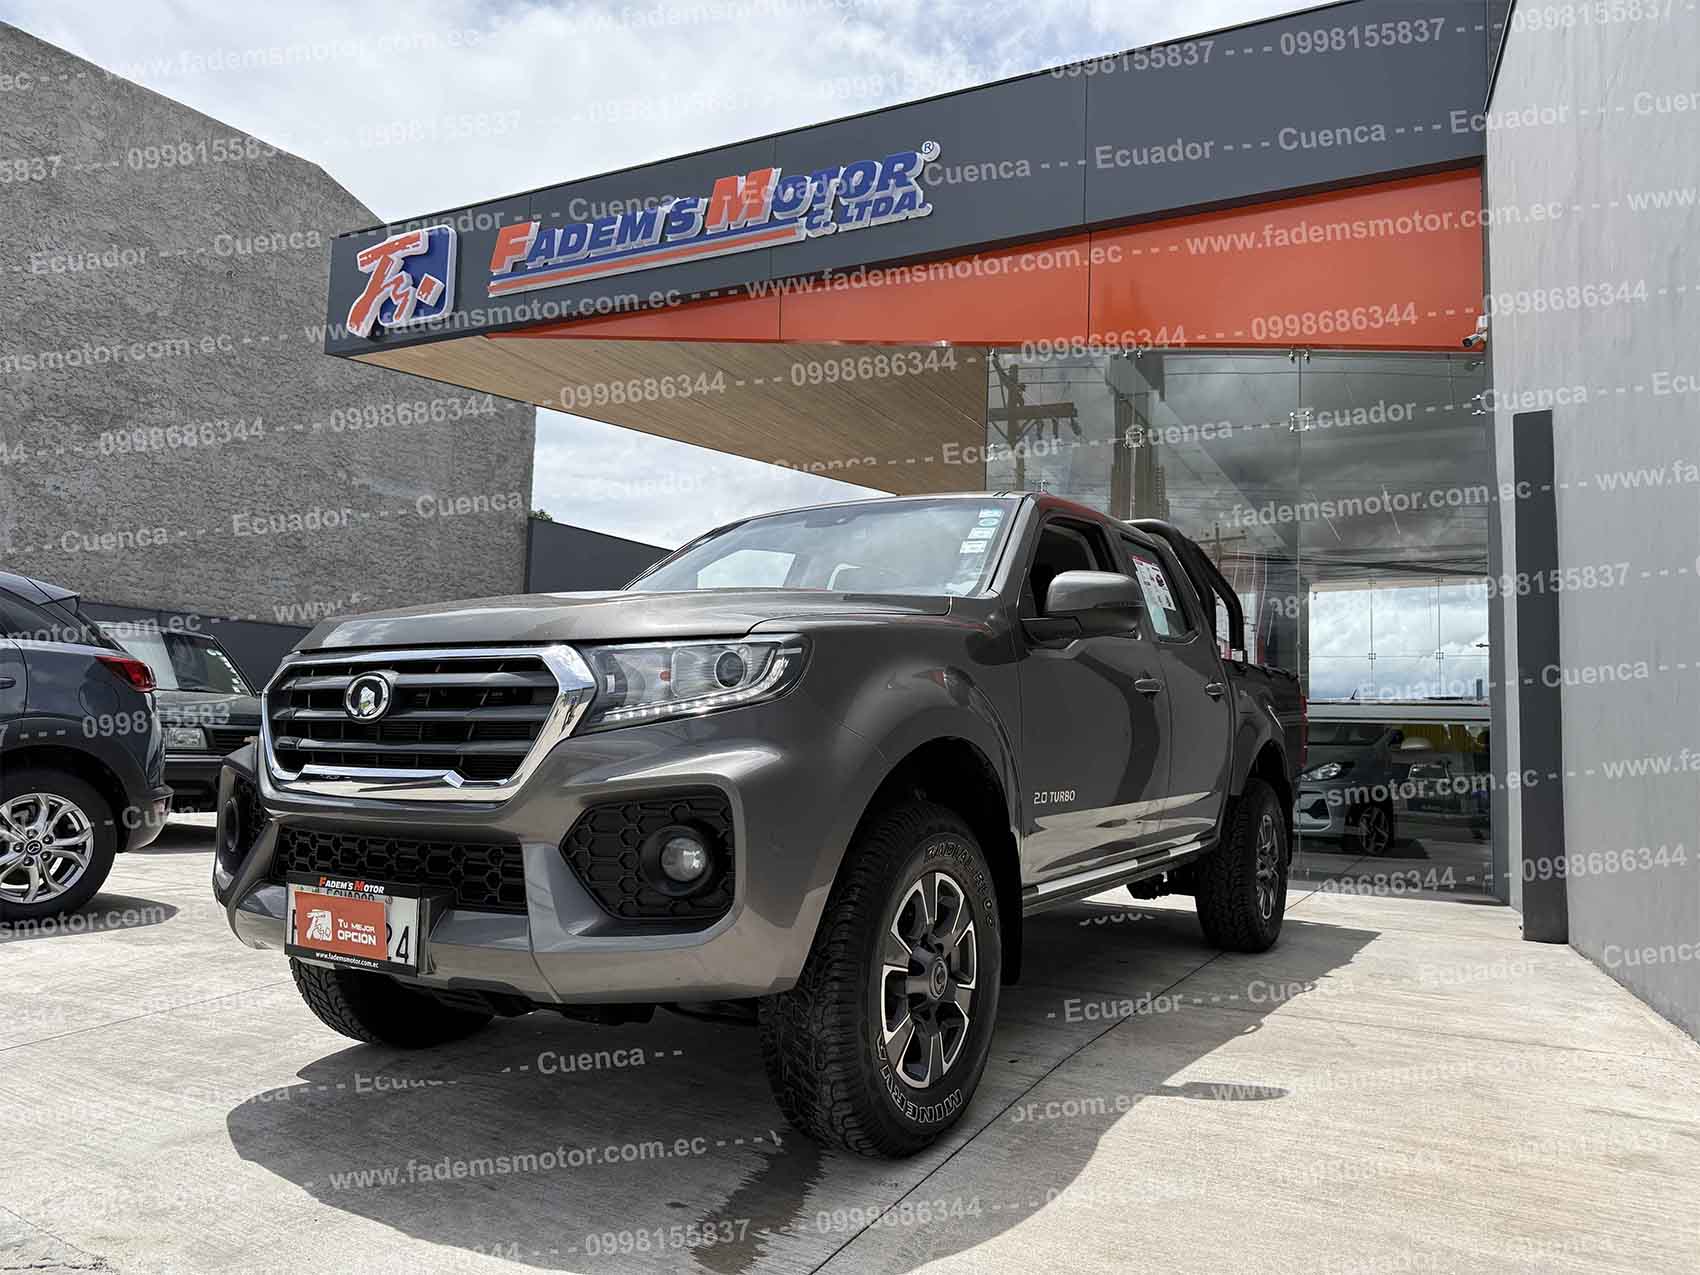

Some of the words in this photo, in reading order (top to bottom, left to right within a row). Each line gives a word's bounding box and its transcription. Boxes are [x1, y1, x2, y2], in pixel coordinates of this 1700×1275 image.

[703, 151, 925, 233] MOTOR
[838, 188, 933, 228] LTDA.
[1050, 789, 1076, 803] TURBO
[354, 880, 385, 894] MOTOR
[337, 918, 348, 928] TU
[351, 922, 375, 934] MEJOR
